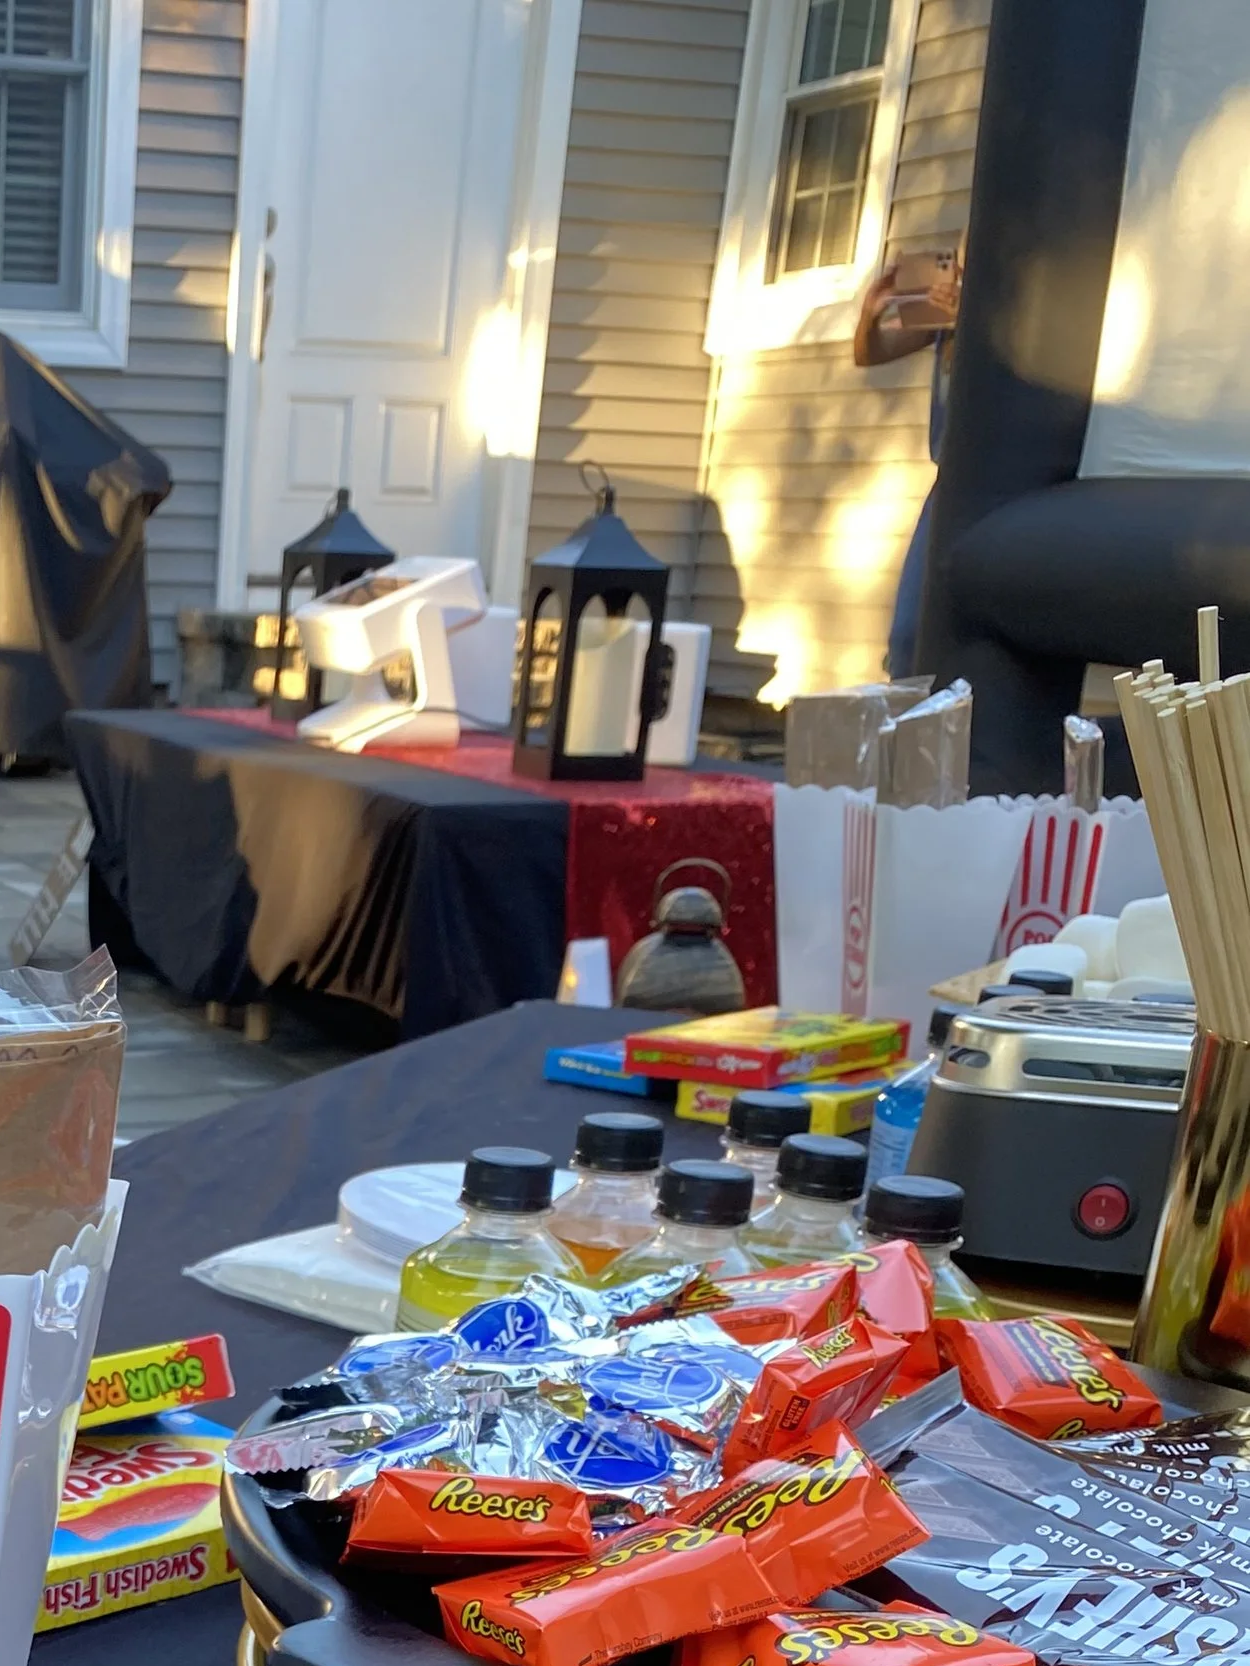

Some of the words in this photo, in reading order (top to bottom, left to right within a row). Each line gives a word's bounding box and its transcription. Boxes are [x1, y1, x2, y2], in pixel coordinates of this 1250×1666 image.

[1022, 929, 1054, 944] PO
[124, 1356, 206, 1402] SOUR
[782, 1399, 802, 1427] GLUTEN
[1152, 1442, 1210, 1455] milk
[431, 1477, 551, 1522] Reese's
[717, 1484, 760, 1513] BUTTER
[1070, 1477, 1193, 1543] chocolate
[105, 1545, 208, 1599] Swedish
[511, 1527, 717, 1602] Reese's
[44, 1572, 101, 1614] Fish
[1172, 1578, 1238, 1608] milk
[461, 1600, 525, 1655] Reese's
[779, 1618, 979, 1664] Reese's
